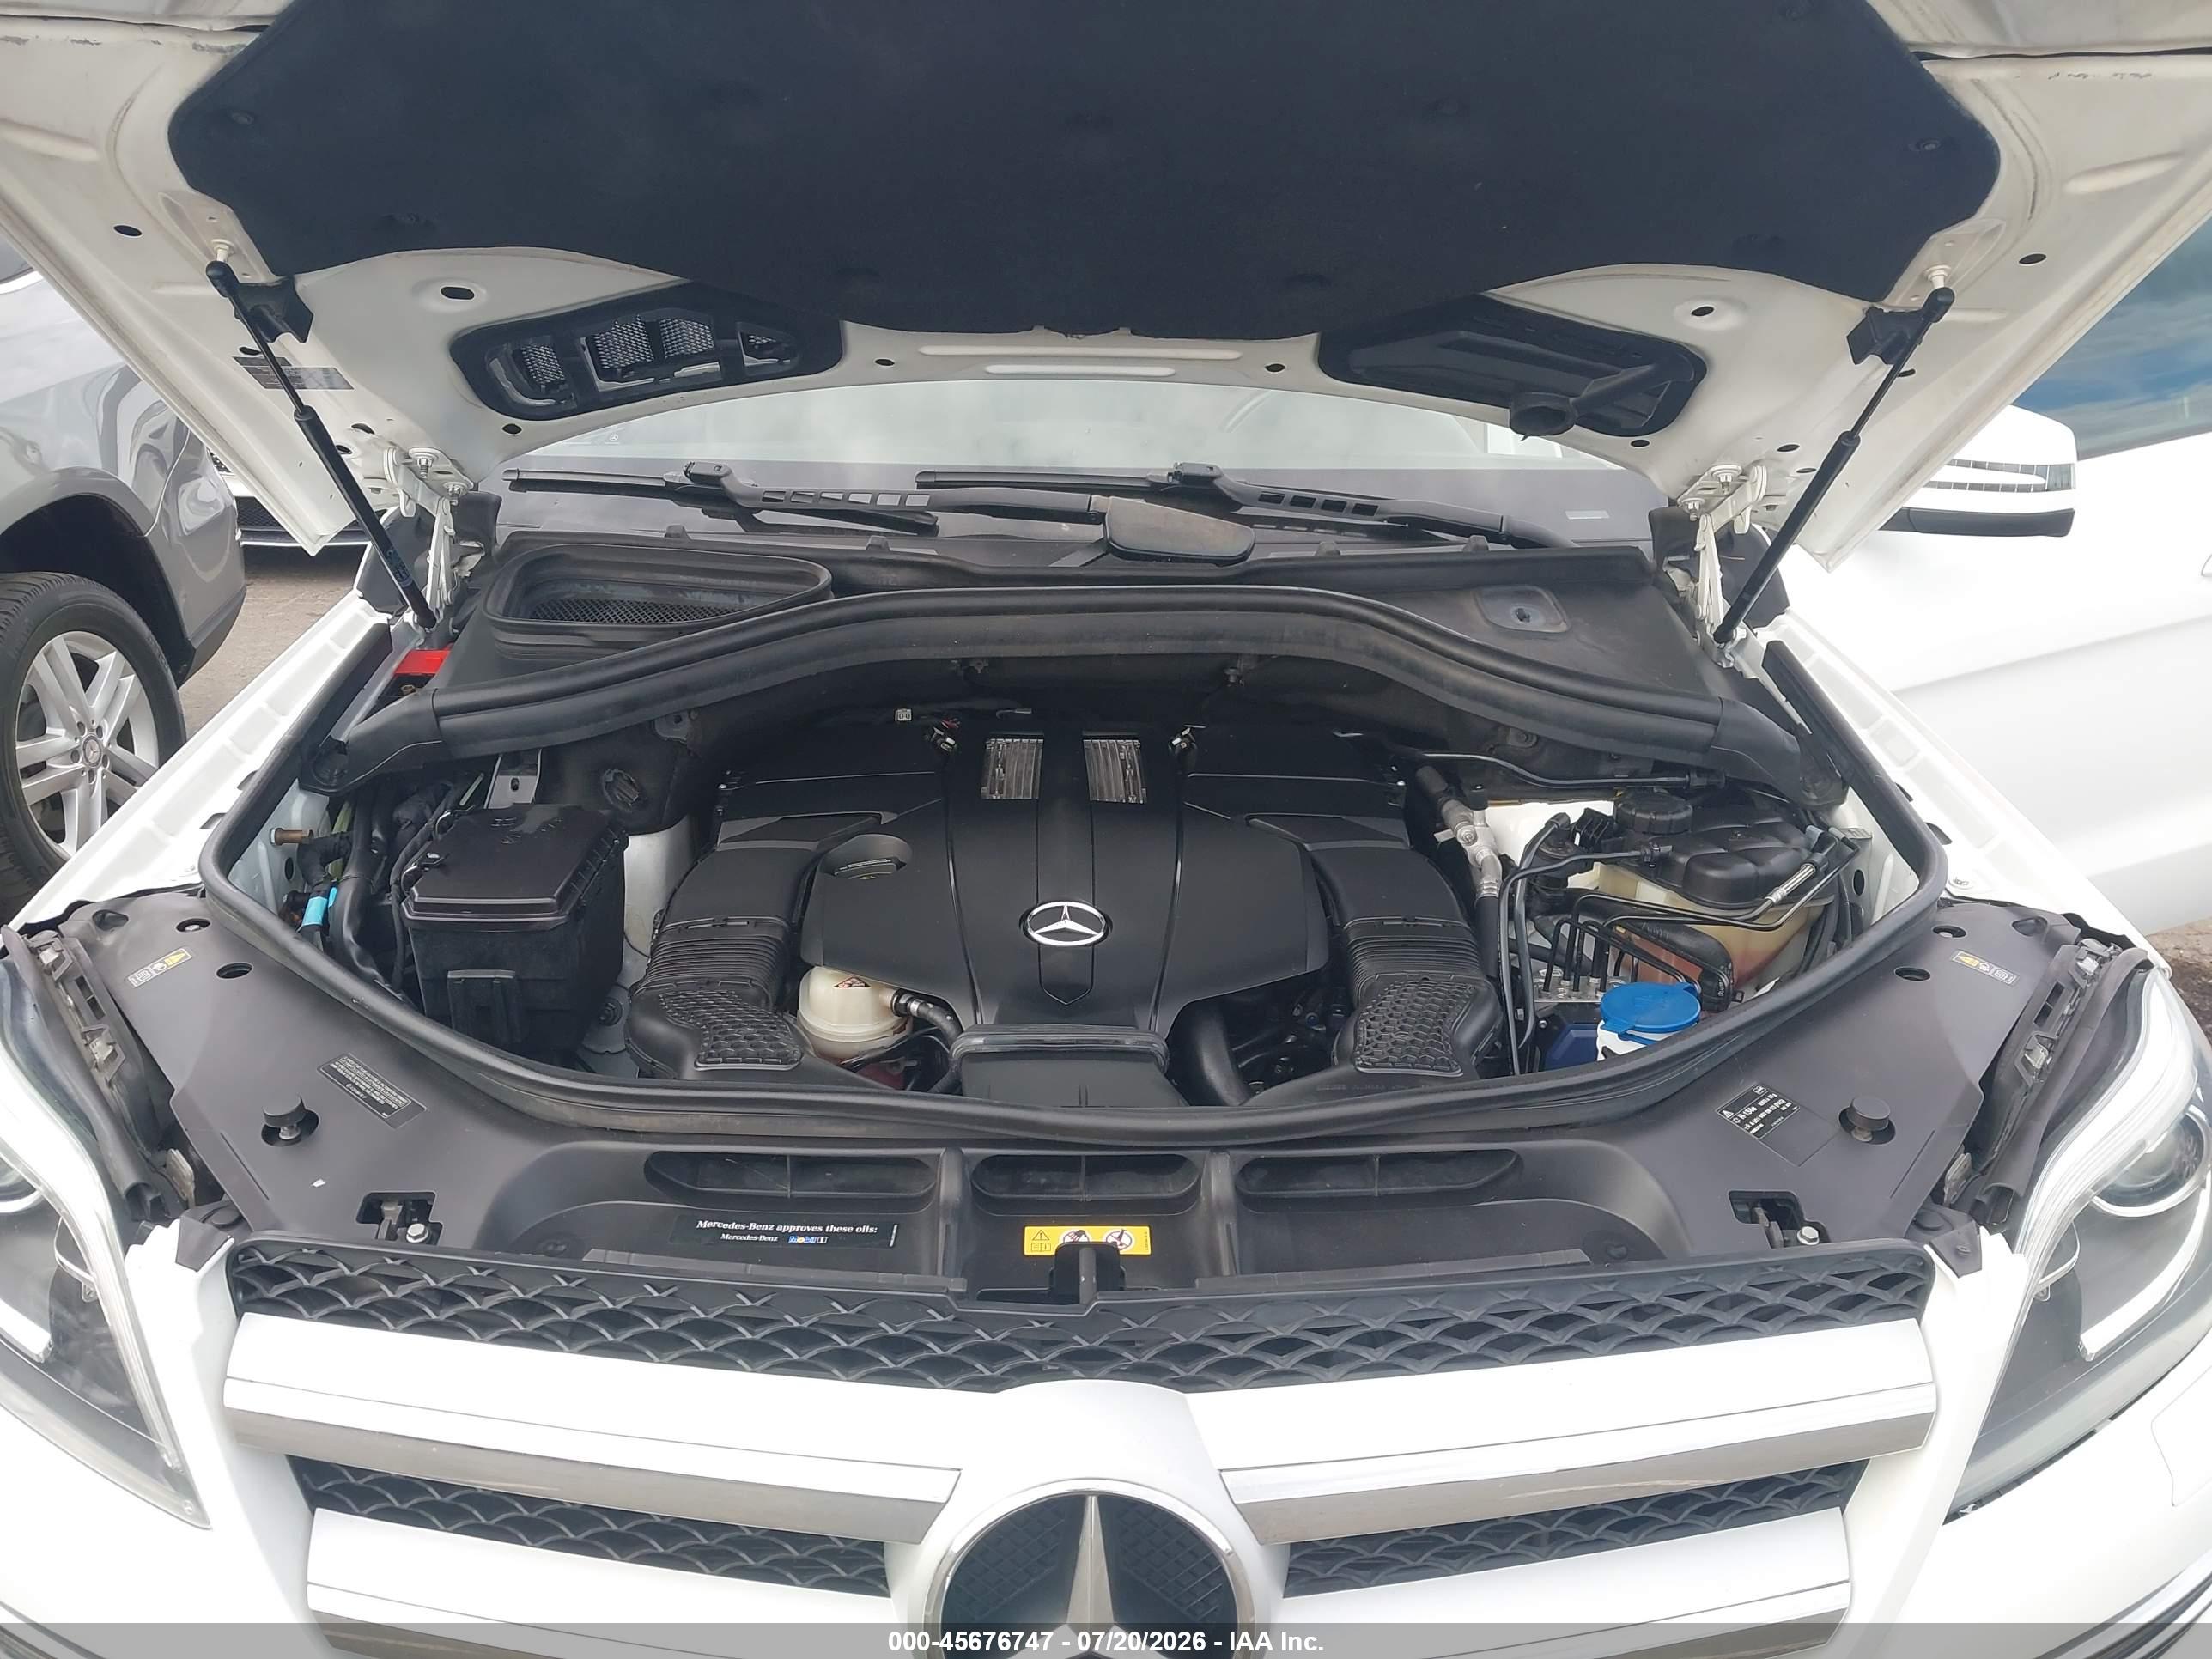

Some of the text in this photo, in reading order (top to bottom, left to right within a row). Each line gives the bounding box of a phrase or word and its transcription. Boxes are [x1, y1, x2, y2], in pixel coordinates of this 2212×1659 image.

[696, 1219, 878, 1234] Mercedes-Benz approves these oils:
[720, 1233, 779, 1242] Mercedes-Benz
[787, 1235, 816, 1243] Mobil
